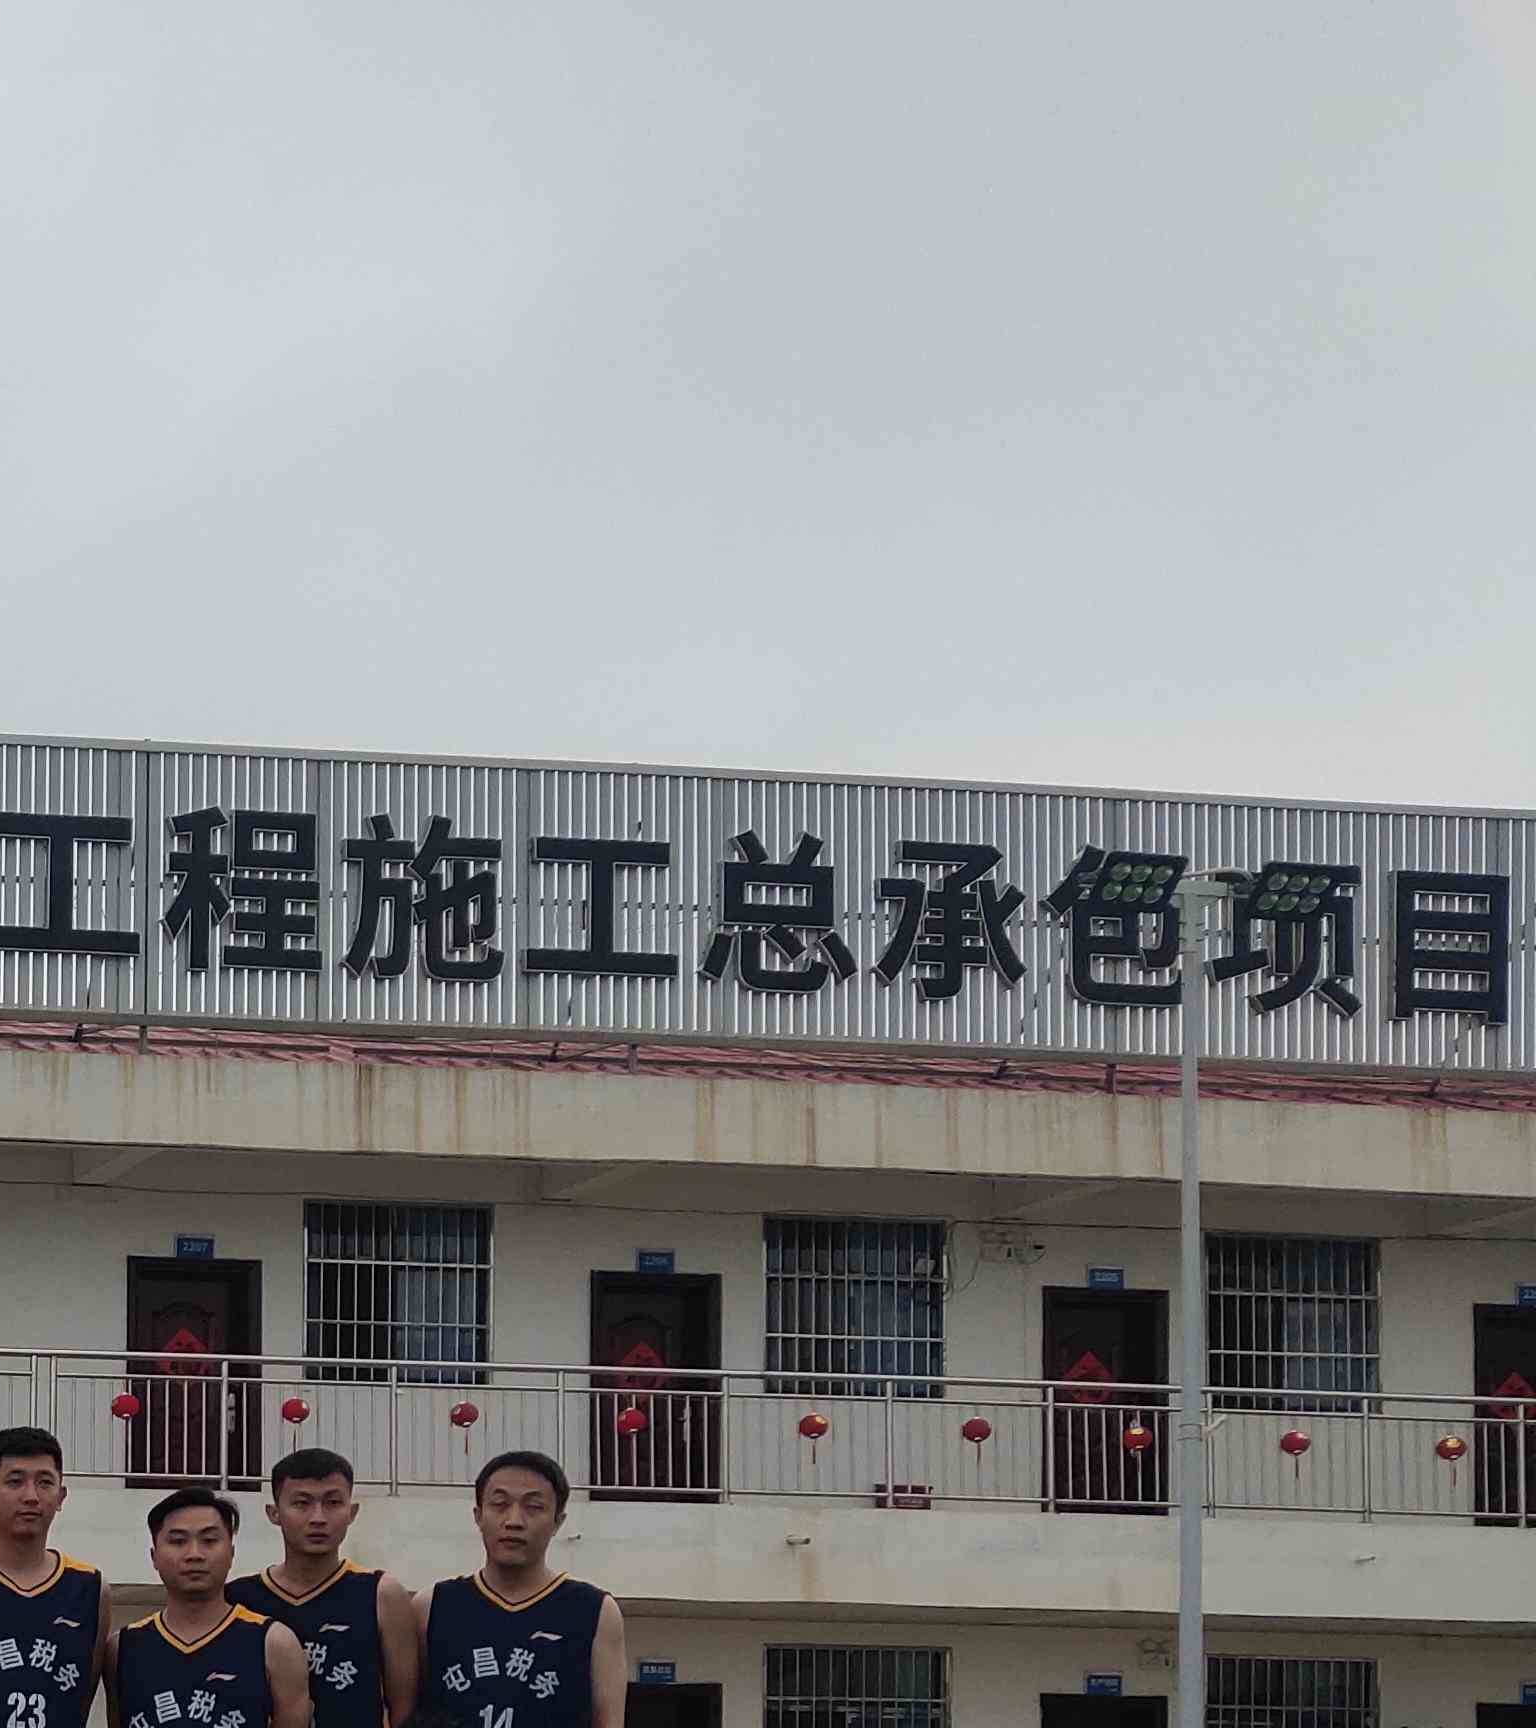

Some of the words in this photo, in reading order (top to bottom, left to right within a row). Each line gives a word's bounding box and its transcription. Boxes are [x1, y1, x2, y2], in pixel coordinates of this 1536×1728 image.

[303, 1641, 359, 1690] 税务
[442, 1645, 561, 1700] 屯昌税务
